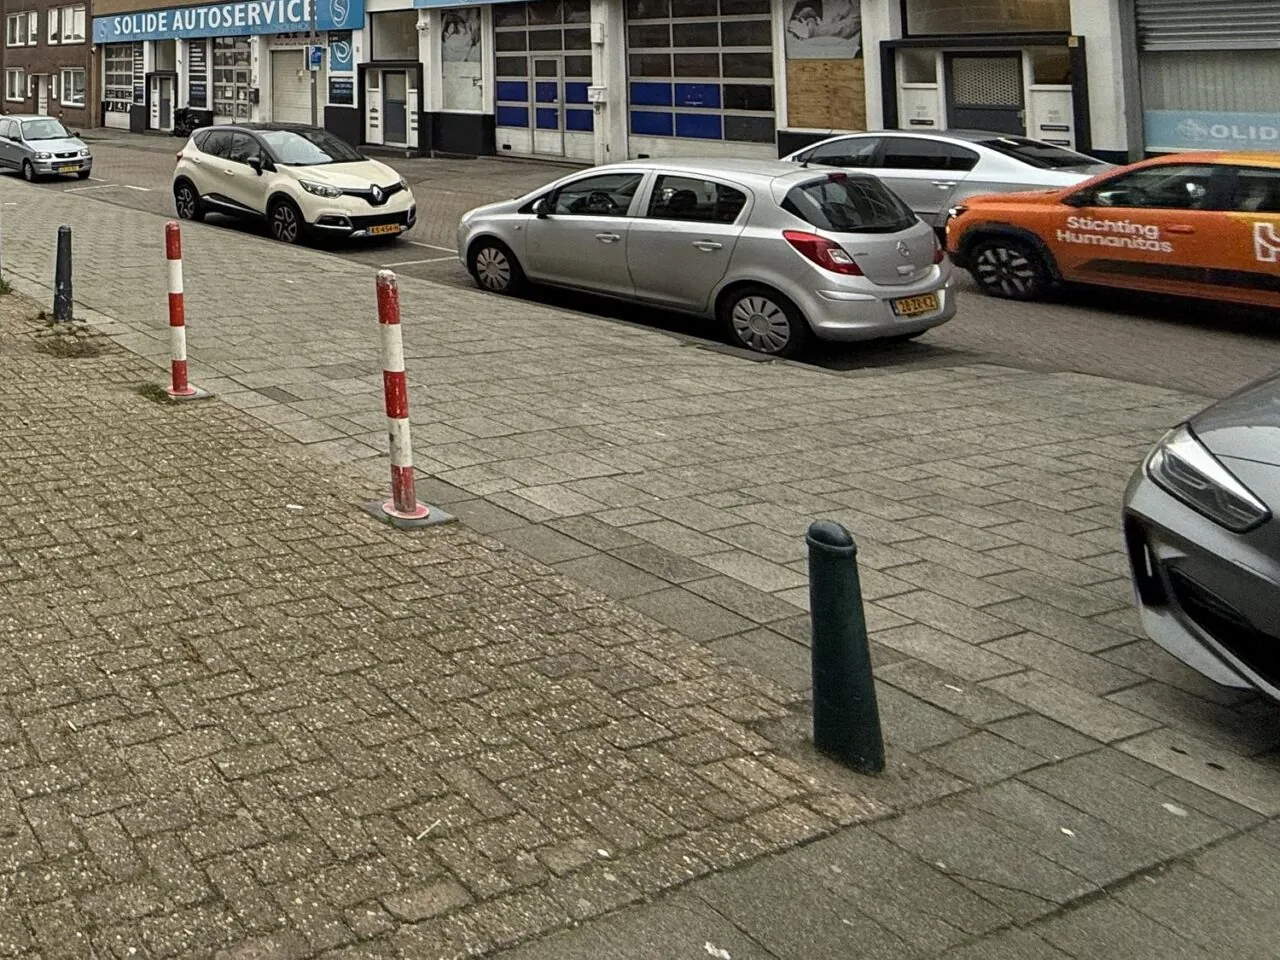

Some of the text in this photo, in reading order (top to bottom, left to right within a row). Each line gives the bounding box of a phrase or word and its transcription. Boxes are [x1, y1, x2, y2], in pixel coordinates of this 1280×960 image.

[114, 12, 167, 35] SOLIDE
[1067, 216, 1160, 239] Stichting
[1056, 229, 1174, 253] Humanitas
